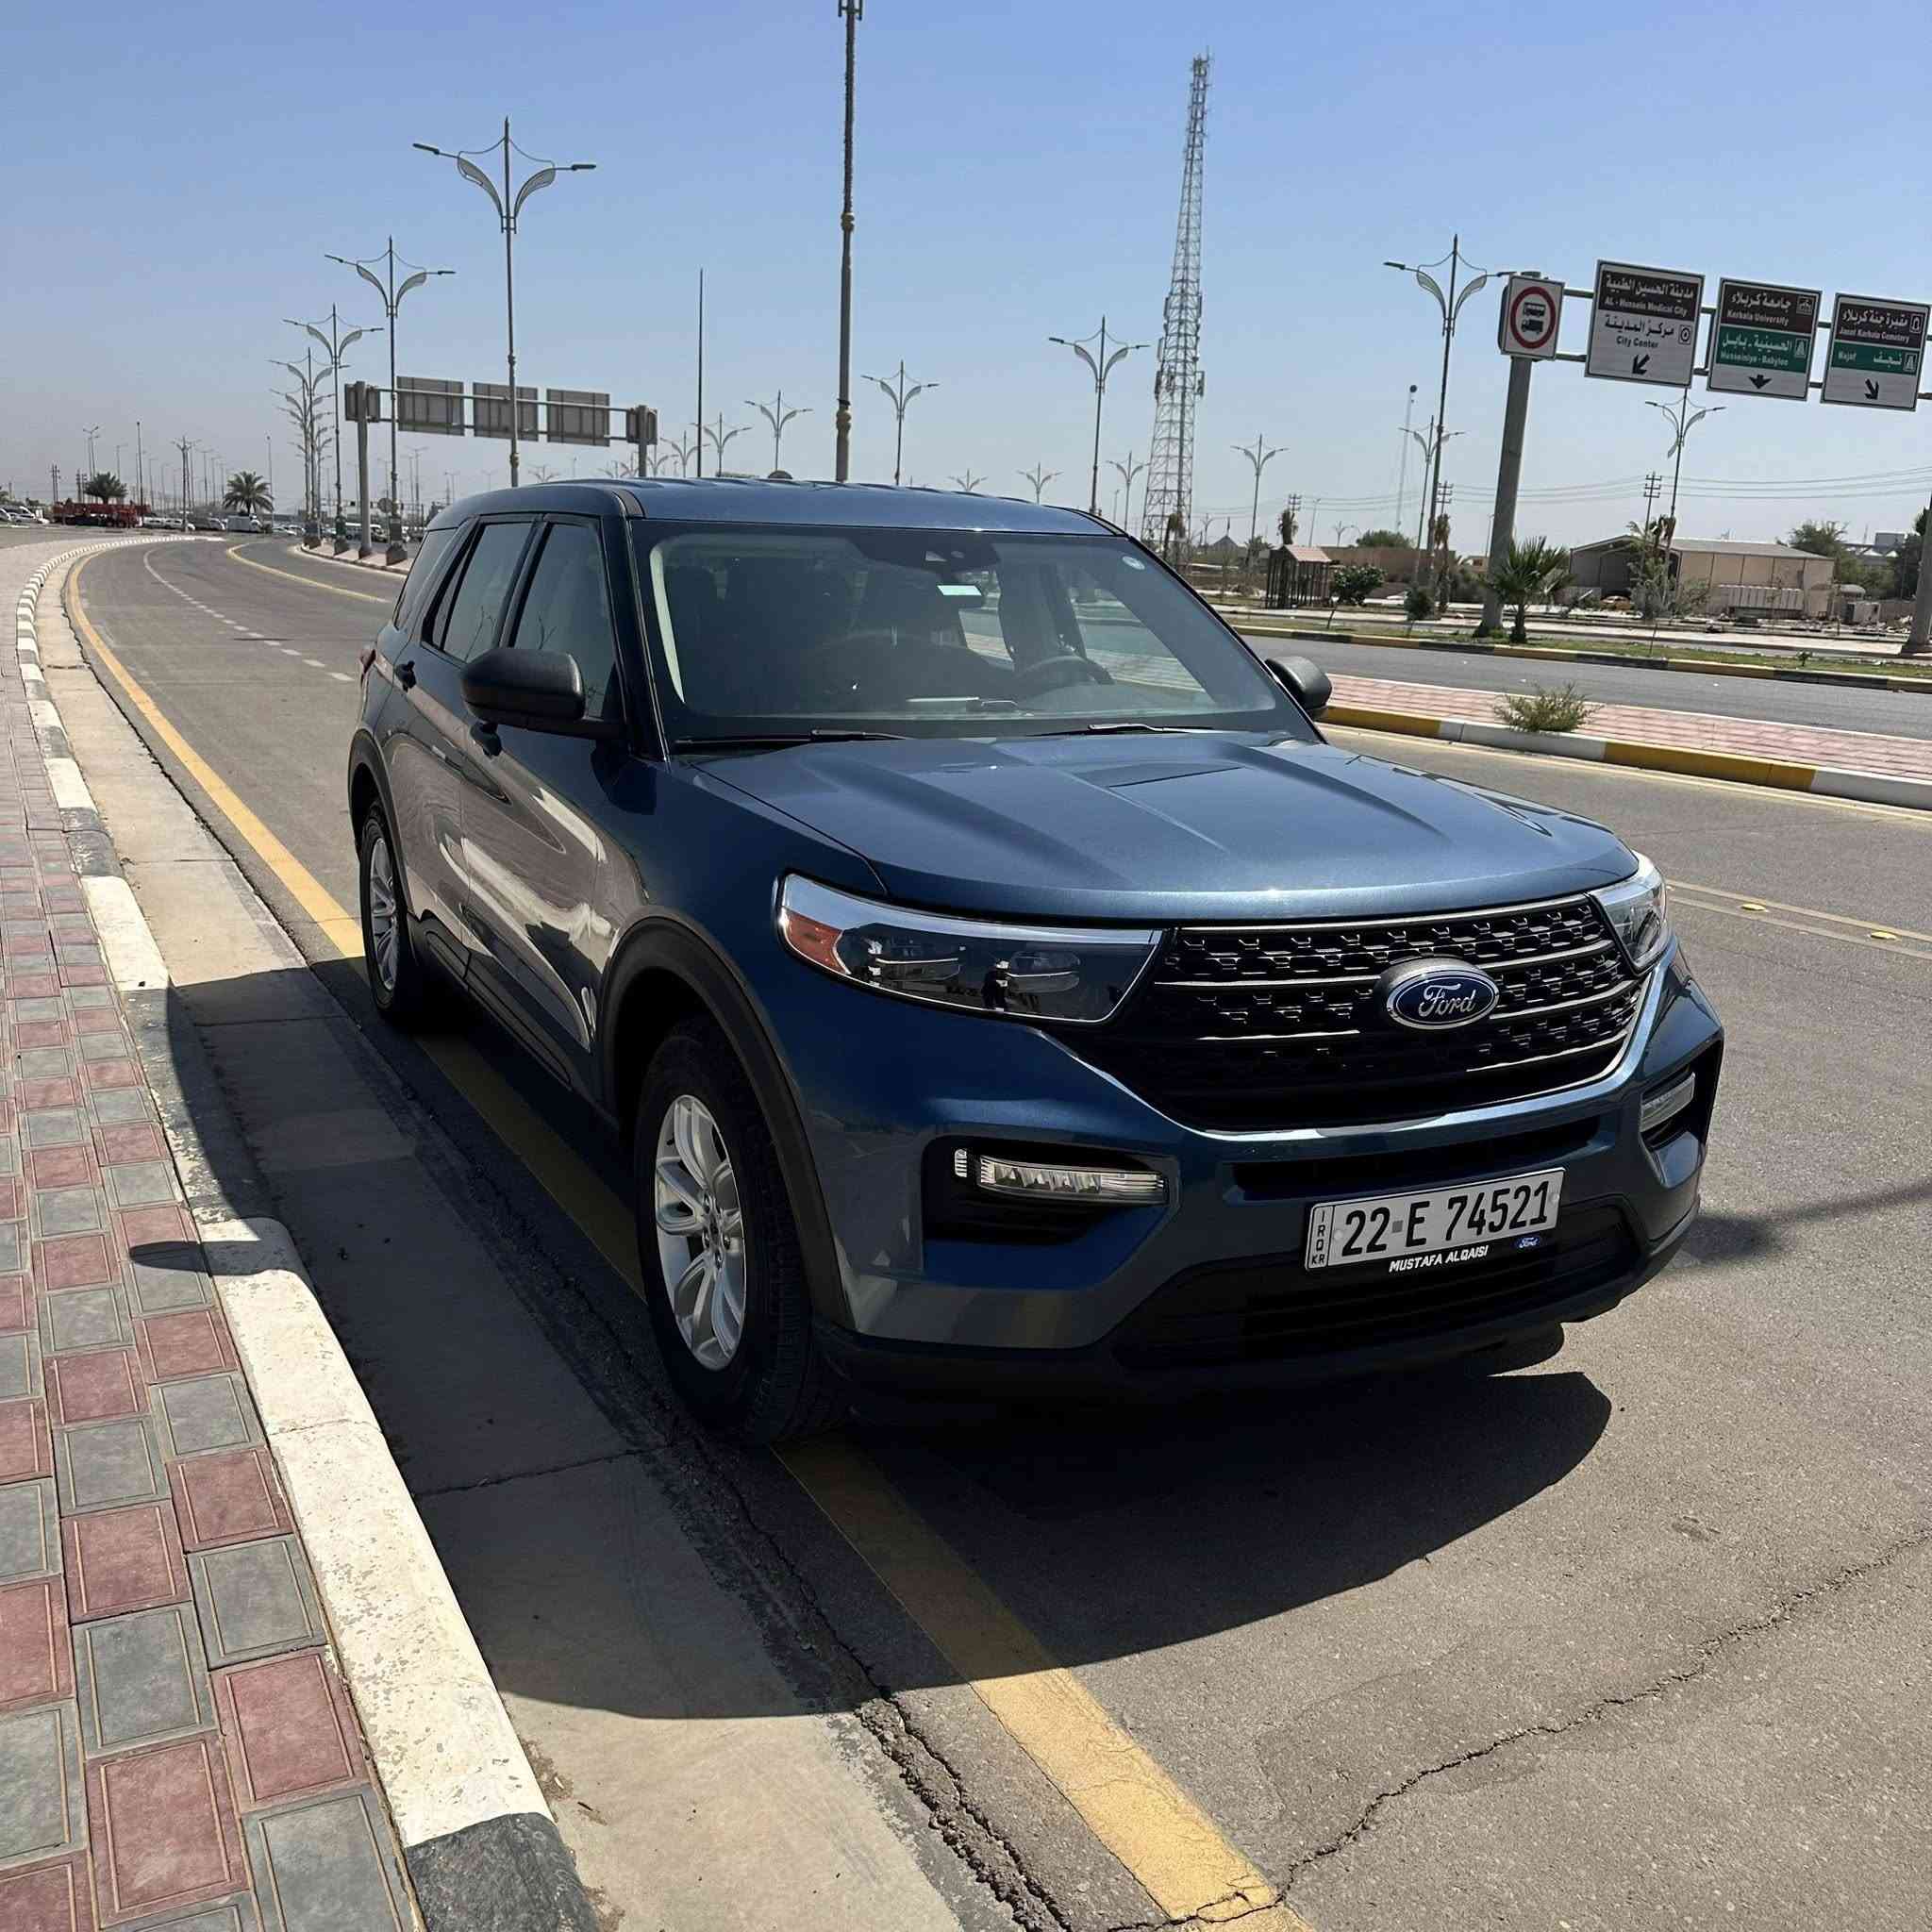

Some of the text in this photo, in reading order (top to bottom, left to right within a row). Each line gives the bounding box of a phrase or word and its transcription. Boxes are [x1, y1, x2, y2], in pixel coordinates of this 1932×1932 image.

[1669, 282, 1694, 303] مدينة
[1731, 291, 1791, 313] جامعة كربلاء
[1674, 305, 1688, 318] City
[1755, 312, 1790, 326] University
[1841, 308, 1869, 325] كربلاء
[1605, 313, 1674, 339] مركز المدينة
[1616, 335, 1659, 349] City Center
[1722, 332, 1748, 350] بابل
[1754, 334, 1792, 353] الحسينية
[1418, 983, 1476, 1017] Ford
[1341, 1180, 1550, 1257] 22 E 74521
[1389, 1244, 1489, 1274] MUSTAFA ALQAISI
